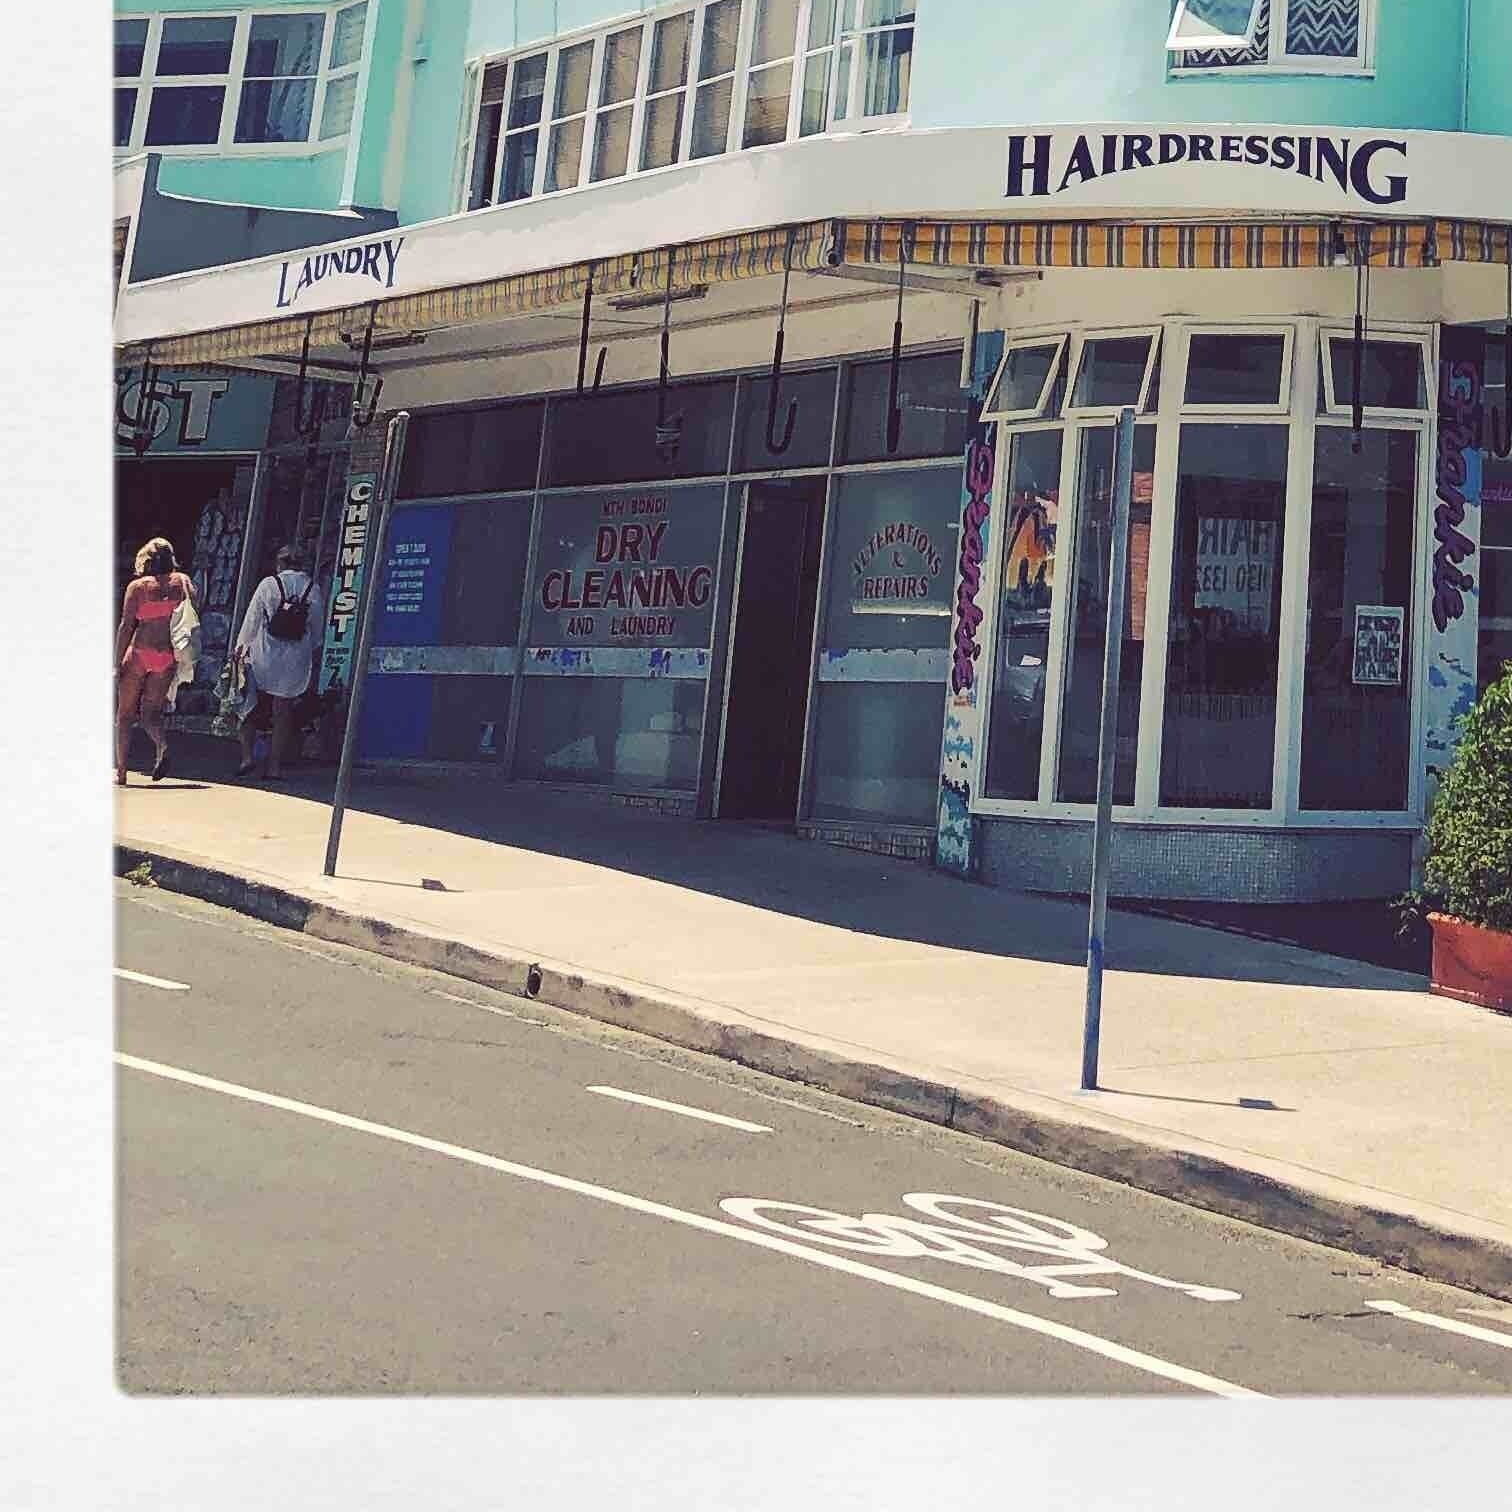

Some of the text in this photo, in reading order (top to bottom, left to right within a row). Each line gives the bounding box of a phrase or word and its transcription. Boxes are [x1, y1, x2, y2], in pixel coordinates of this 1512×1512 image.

[1003, 133, 1408, 205] HAIRDRESSING
[276, 237, 405, 307] LAUNDRY
[114, 377, 230, 445] ST
[328, 481, 374, 634] CHEMIST
[594, 520, 669, 564] DRY
[541, 566, 713, 612] CLEANING
[862, 575, 929, 600] REPAIRS
[567, 615, 676, 637] AND LAUNDRY
